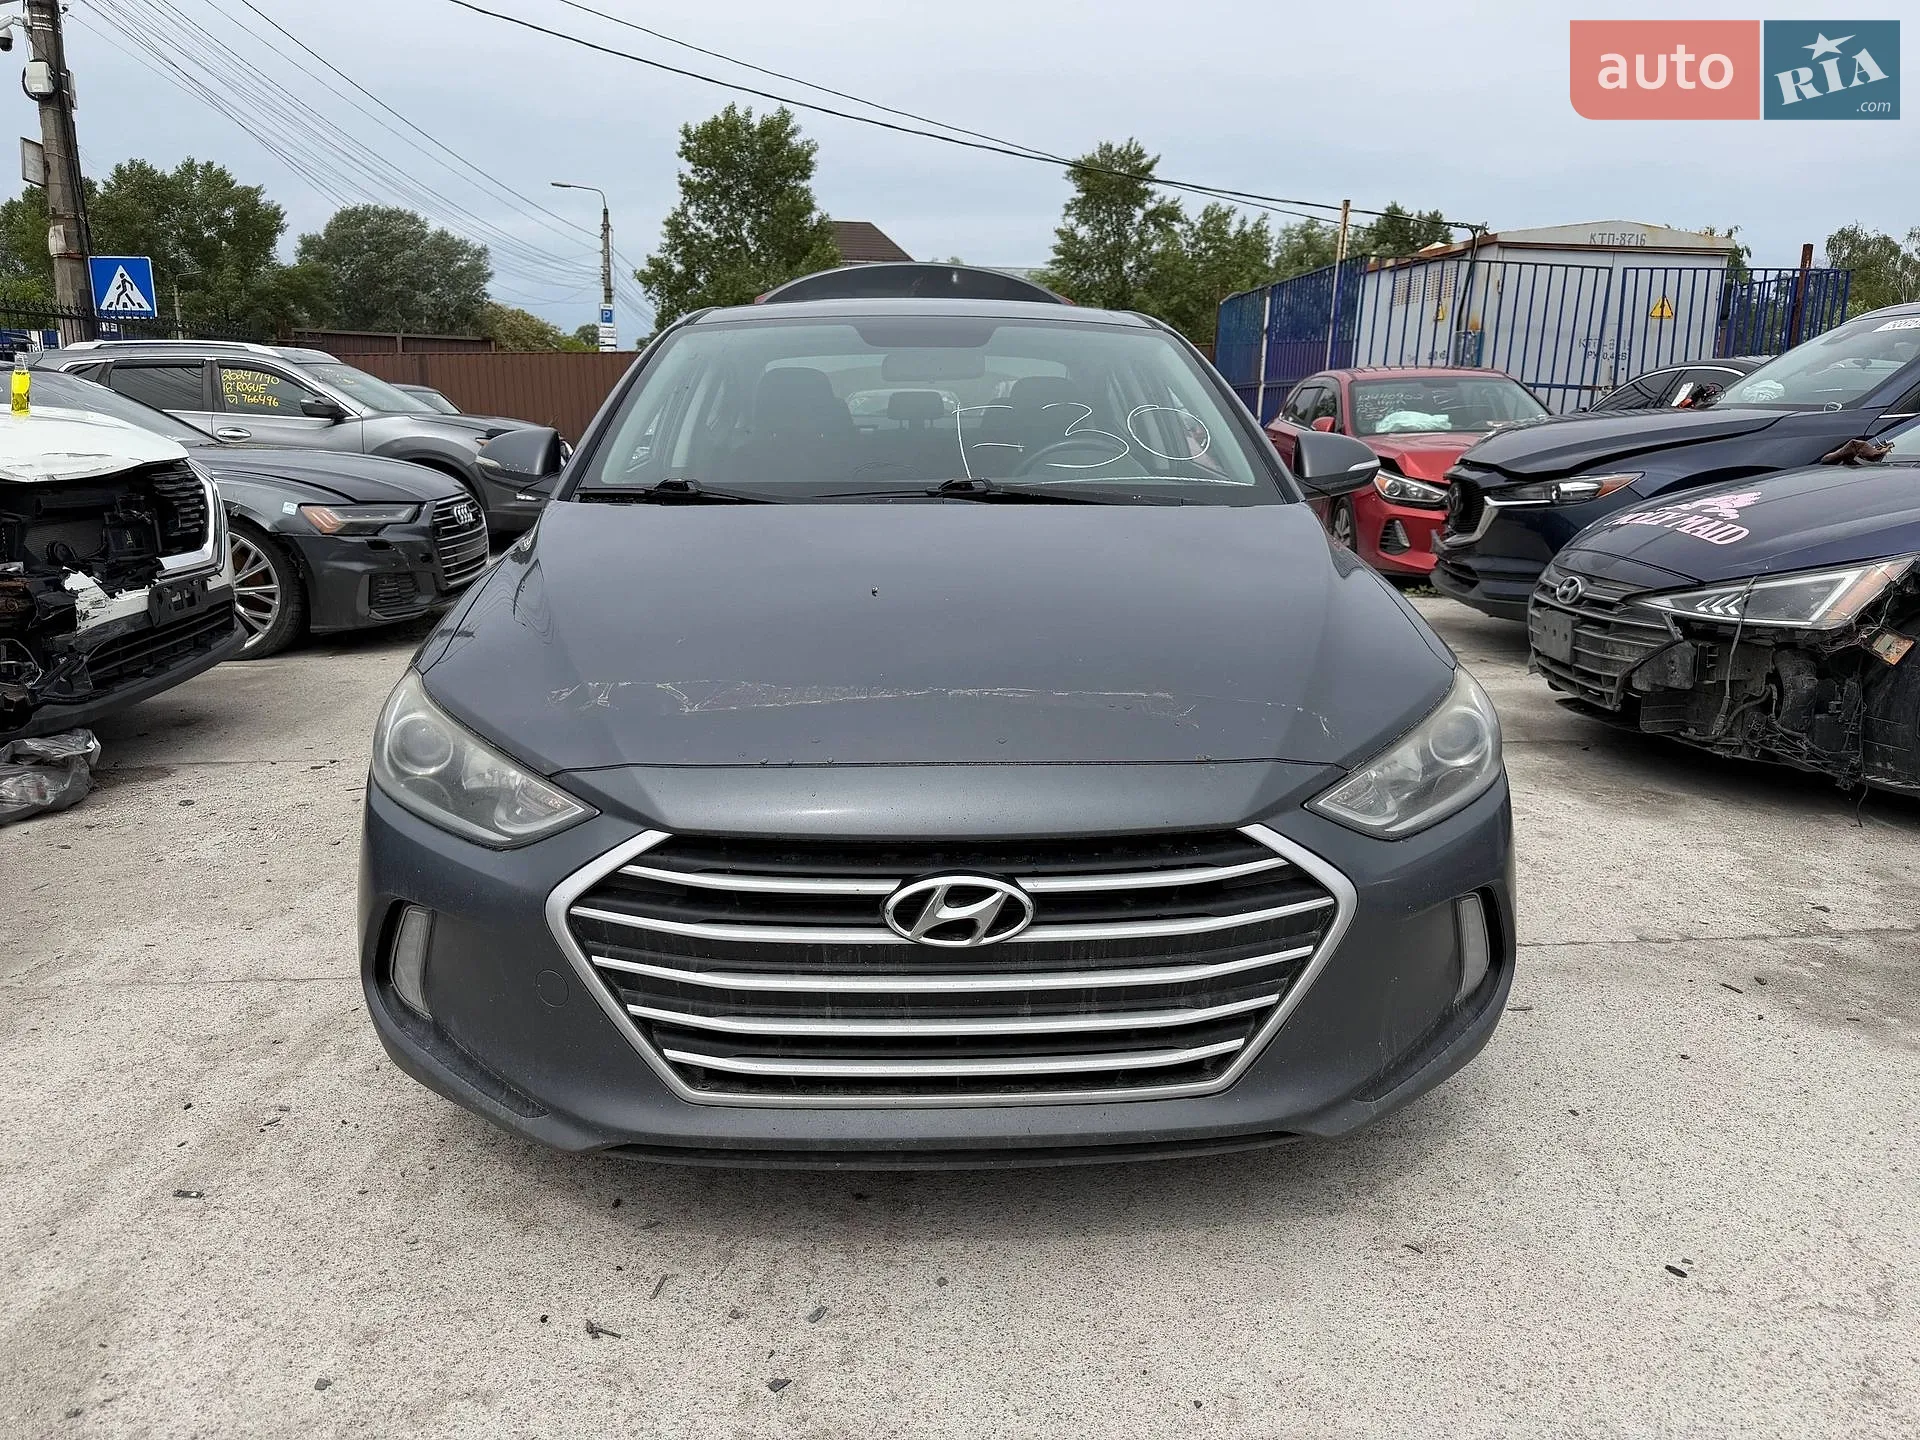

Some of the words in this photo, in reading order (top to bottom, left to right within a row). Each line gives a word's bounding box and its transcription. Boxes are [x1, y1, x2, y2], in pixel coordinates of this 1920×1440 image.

[237, 382, 267, 393] ROGUE
[242, 394, 279, 407] 766496
[1676, 515, 1750, 545] MAID
